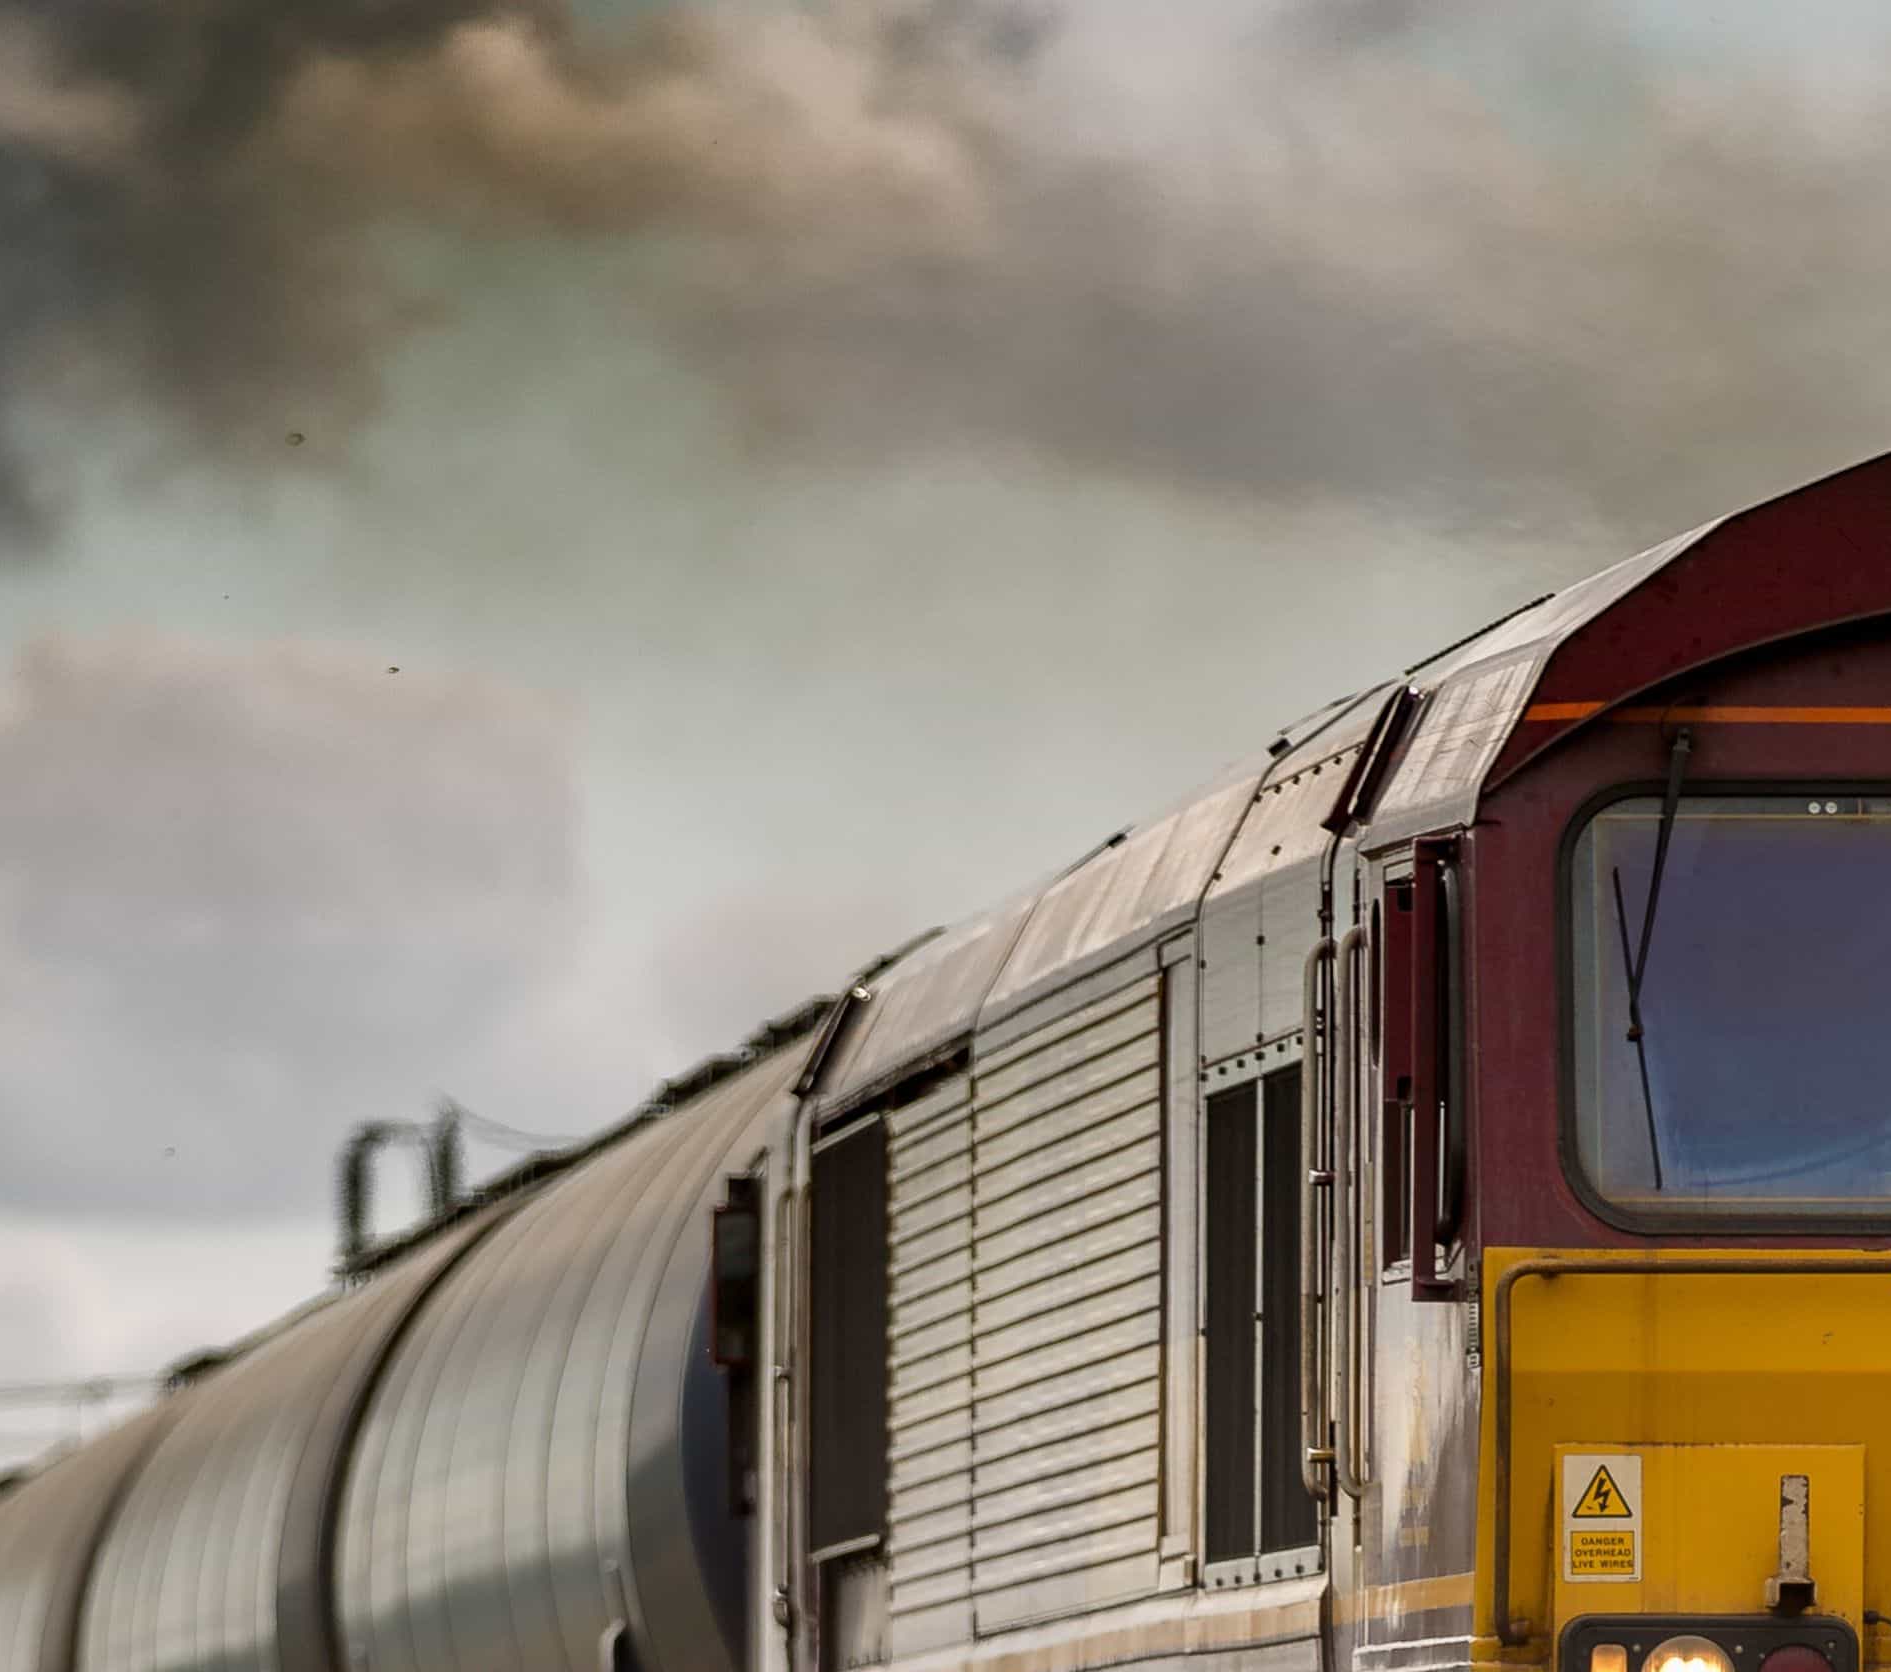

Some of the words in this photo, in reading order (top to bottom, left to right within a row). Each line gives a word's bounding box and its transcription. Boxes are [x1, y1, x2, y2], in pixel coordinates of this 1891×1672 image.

[1581, 1537, 1625, 1546] DANGER
[1574, 1548, 1632, 1557] OVERHEAD
[1572, 1559, 1596, 1569] LIVE
[1600, 1559, 1634, 1569] WIRES
